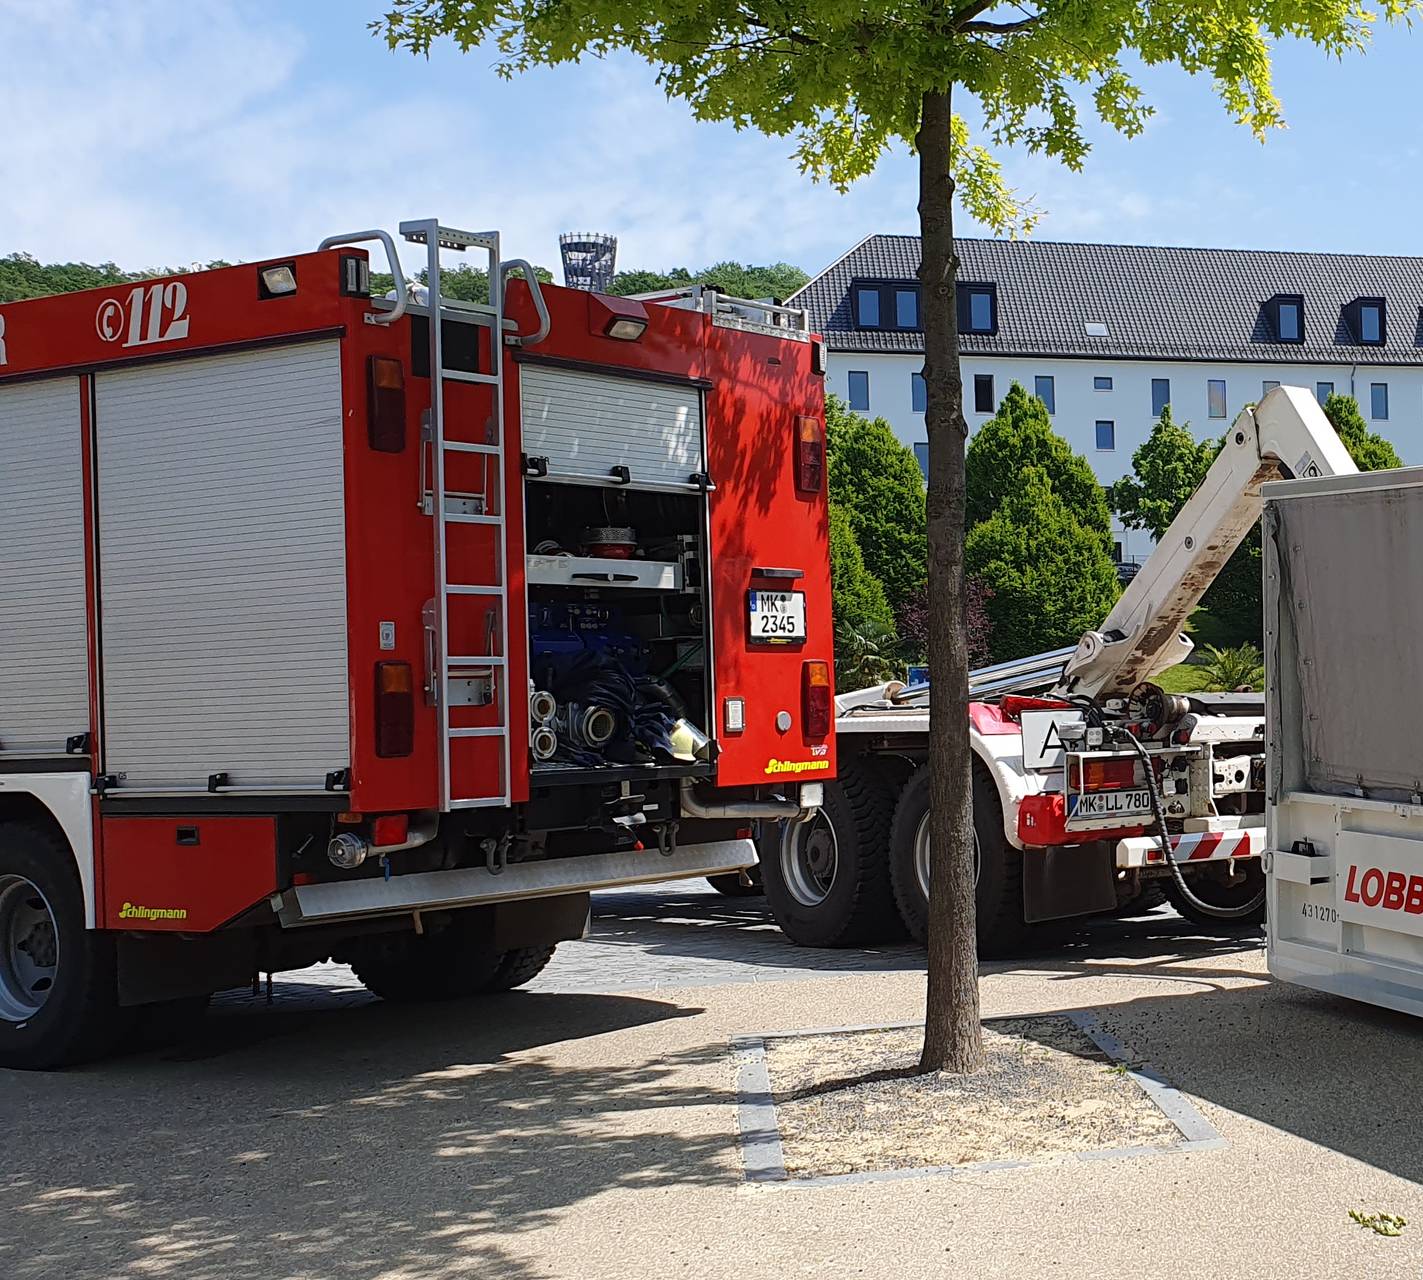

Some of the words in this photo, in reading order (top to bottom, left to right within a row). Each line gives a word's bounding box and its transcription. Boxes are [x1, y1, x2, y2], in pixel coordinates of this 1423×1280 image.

[122, 281, 190, 348] 112
[760, 594, 779, 613] MK
[761, 615, 796, 633] 2345
[1039, 720, 1070, 759] A
[764, 759, 829, 774] Schlingmann
[1079, 795, 1097, 813] MK
[1105, 794, 1123, 811] LL
[1126, 792, 1150, 809] 780
[119, 902, 187, 921] Schlingmann
[1302, 902, 1337, 924] 431270
